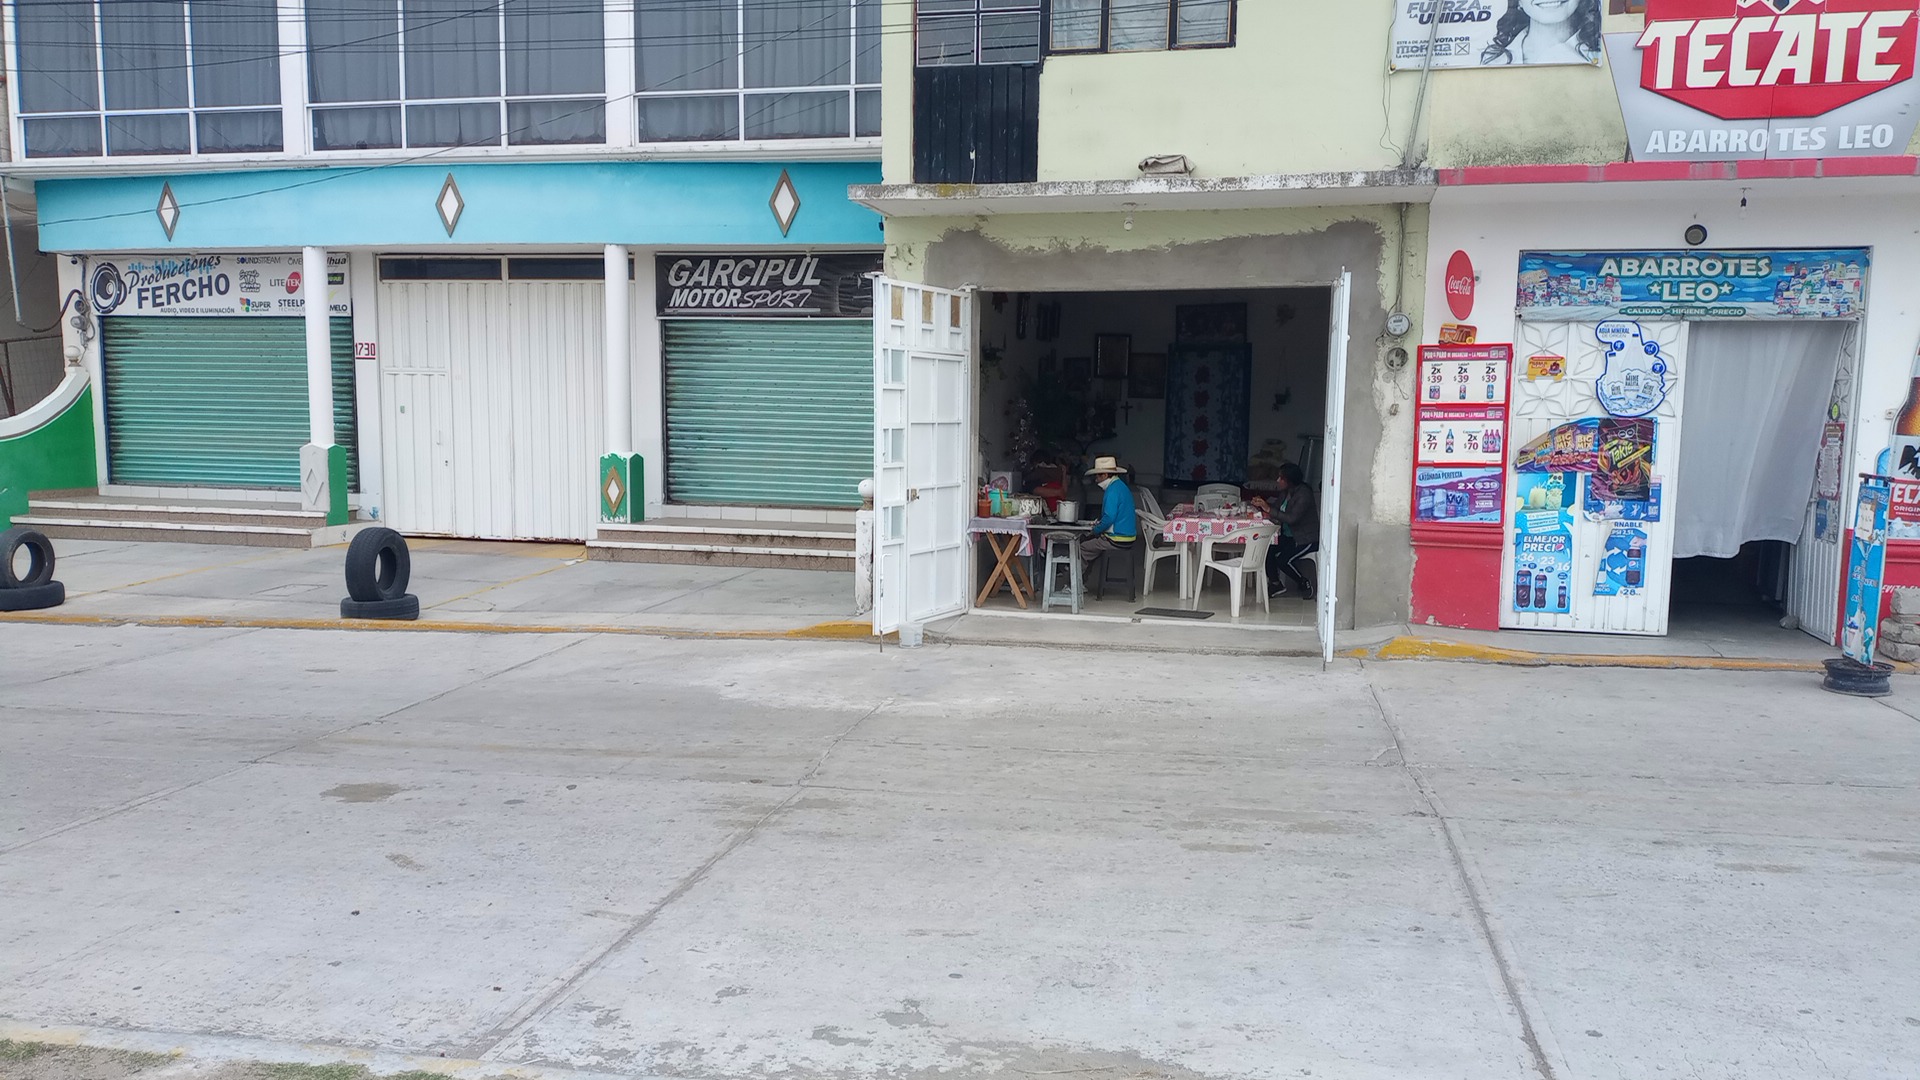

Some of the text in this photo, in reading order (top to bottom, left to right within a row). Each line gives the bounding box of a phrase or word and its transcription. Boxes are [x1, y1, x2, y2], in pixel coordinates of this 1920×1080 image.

[1635, 10, 1913, 89] TECATE
[1838, 124, 1894, 150] LEO
[236, 256, 280, 264] SOUNDSTREAM
[1599, 258, 1771, 277] ABARROTES
[124, 256, 221, 294] Producciones
[668, 258, 821, 286] GARCIPUL
[137, 273, 230, 310] FERCHO
[355, 343, 376, 356] 1730
[1556, 434, 1572, 442] BIG
[1556, 442, 1572, 450] MIX
